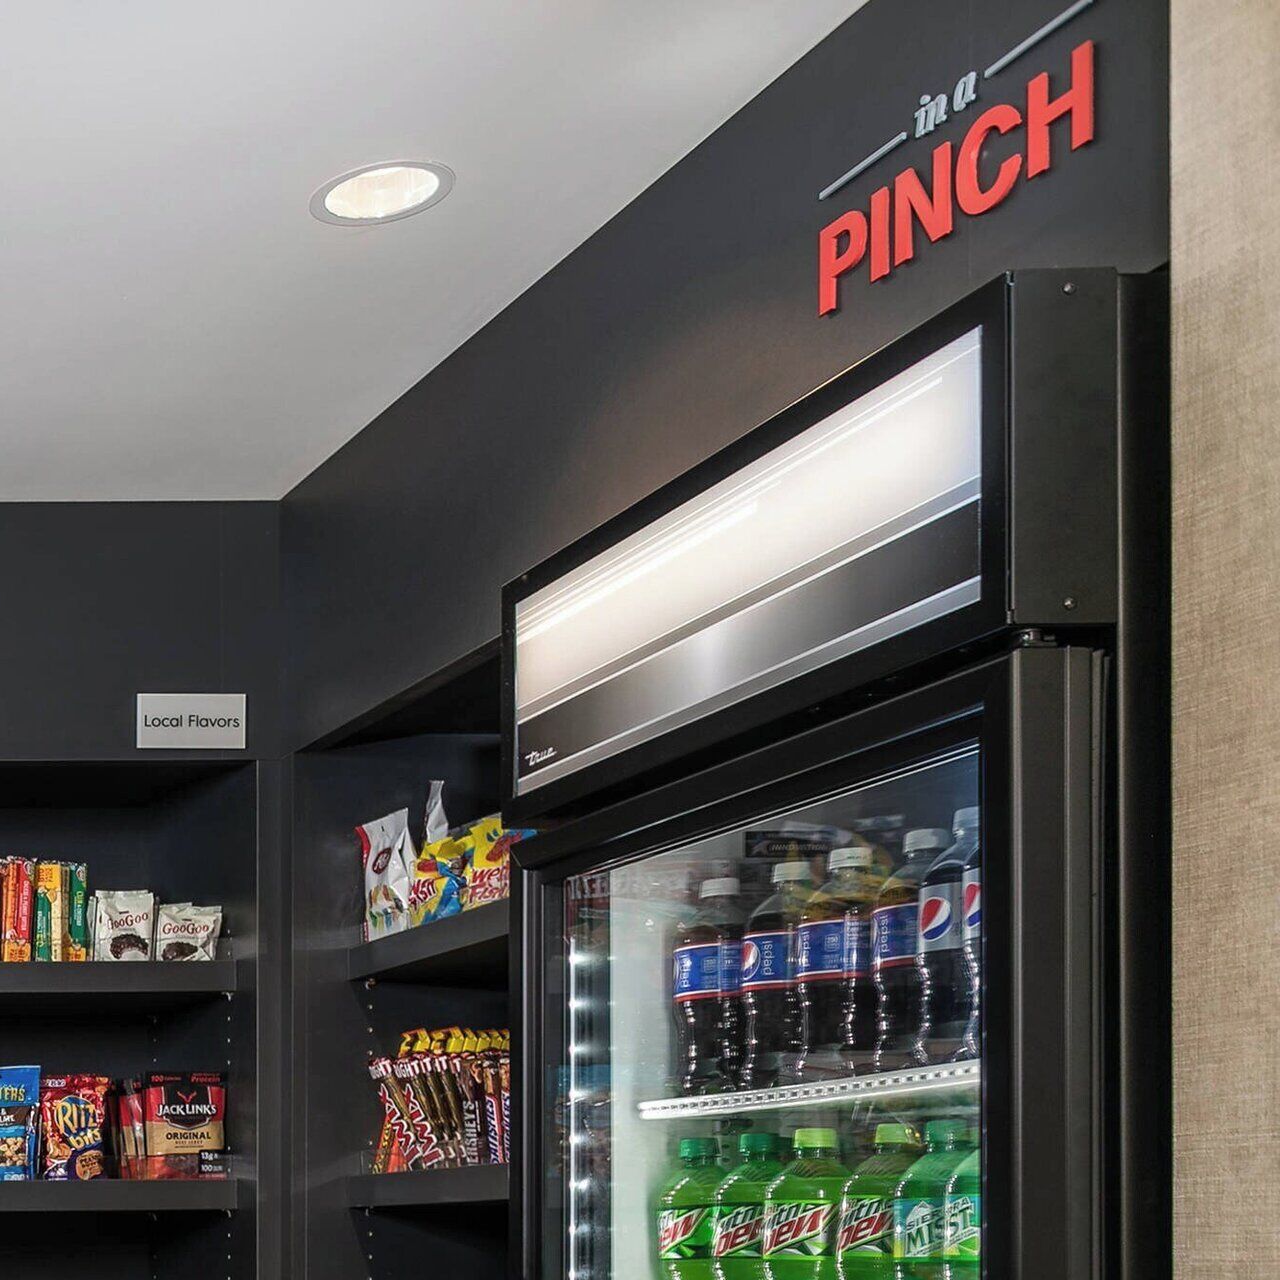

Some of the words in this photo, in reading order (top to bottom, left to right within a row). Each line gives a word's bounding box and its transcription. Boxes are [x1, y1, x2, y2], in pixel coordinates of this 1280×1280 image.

[914, 94, 948, 138] in
[952, 71, 978, 112] a
[818, 39, 1094, 317] PINCH
[144, 714, 183, 728] Local
[188, 714, 240, 728] Flavors
[162, 922, 210, 936] GooGoo
[880, 915, 891, 953] pepsi
[762, 940, 774, 977] pepsi
[801, 930, 811, 968] pepsi
[55, 1100, 98, 1134] RITZ
[156, 1104, 185, 1117] JACK
[69, 1129, 102, 1150] bits
[165, 1132, 211, 1141] ORIGINAL
